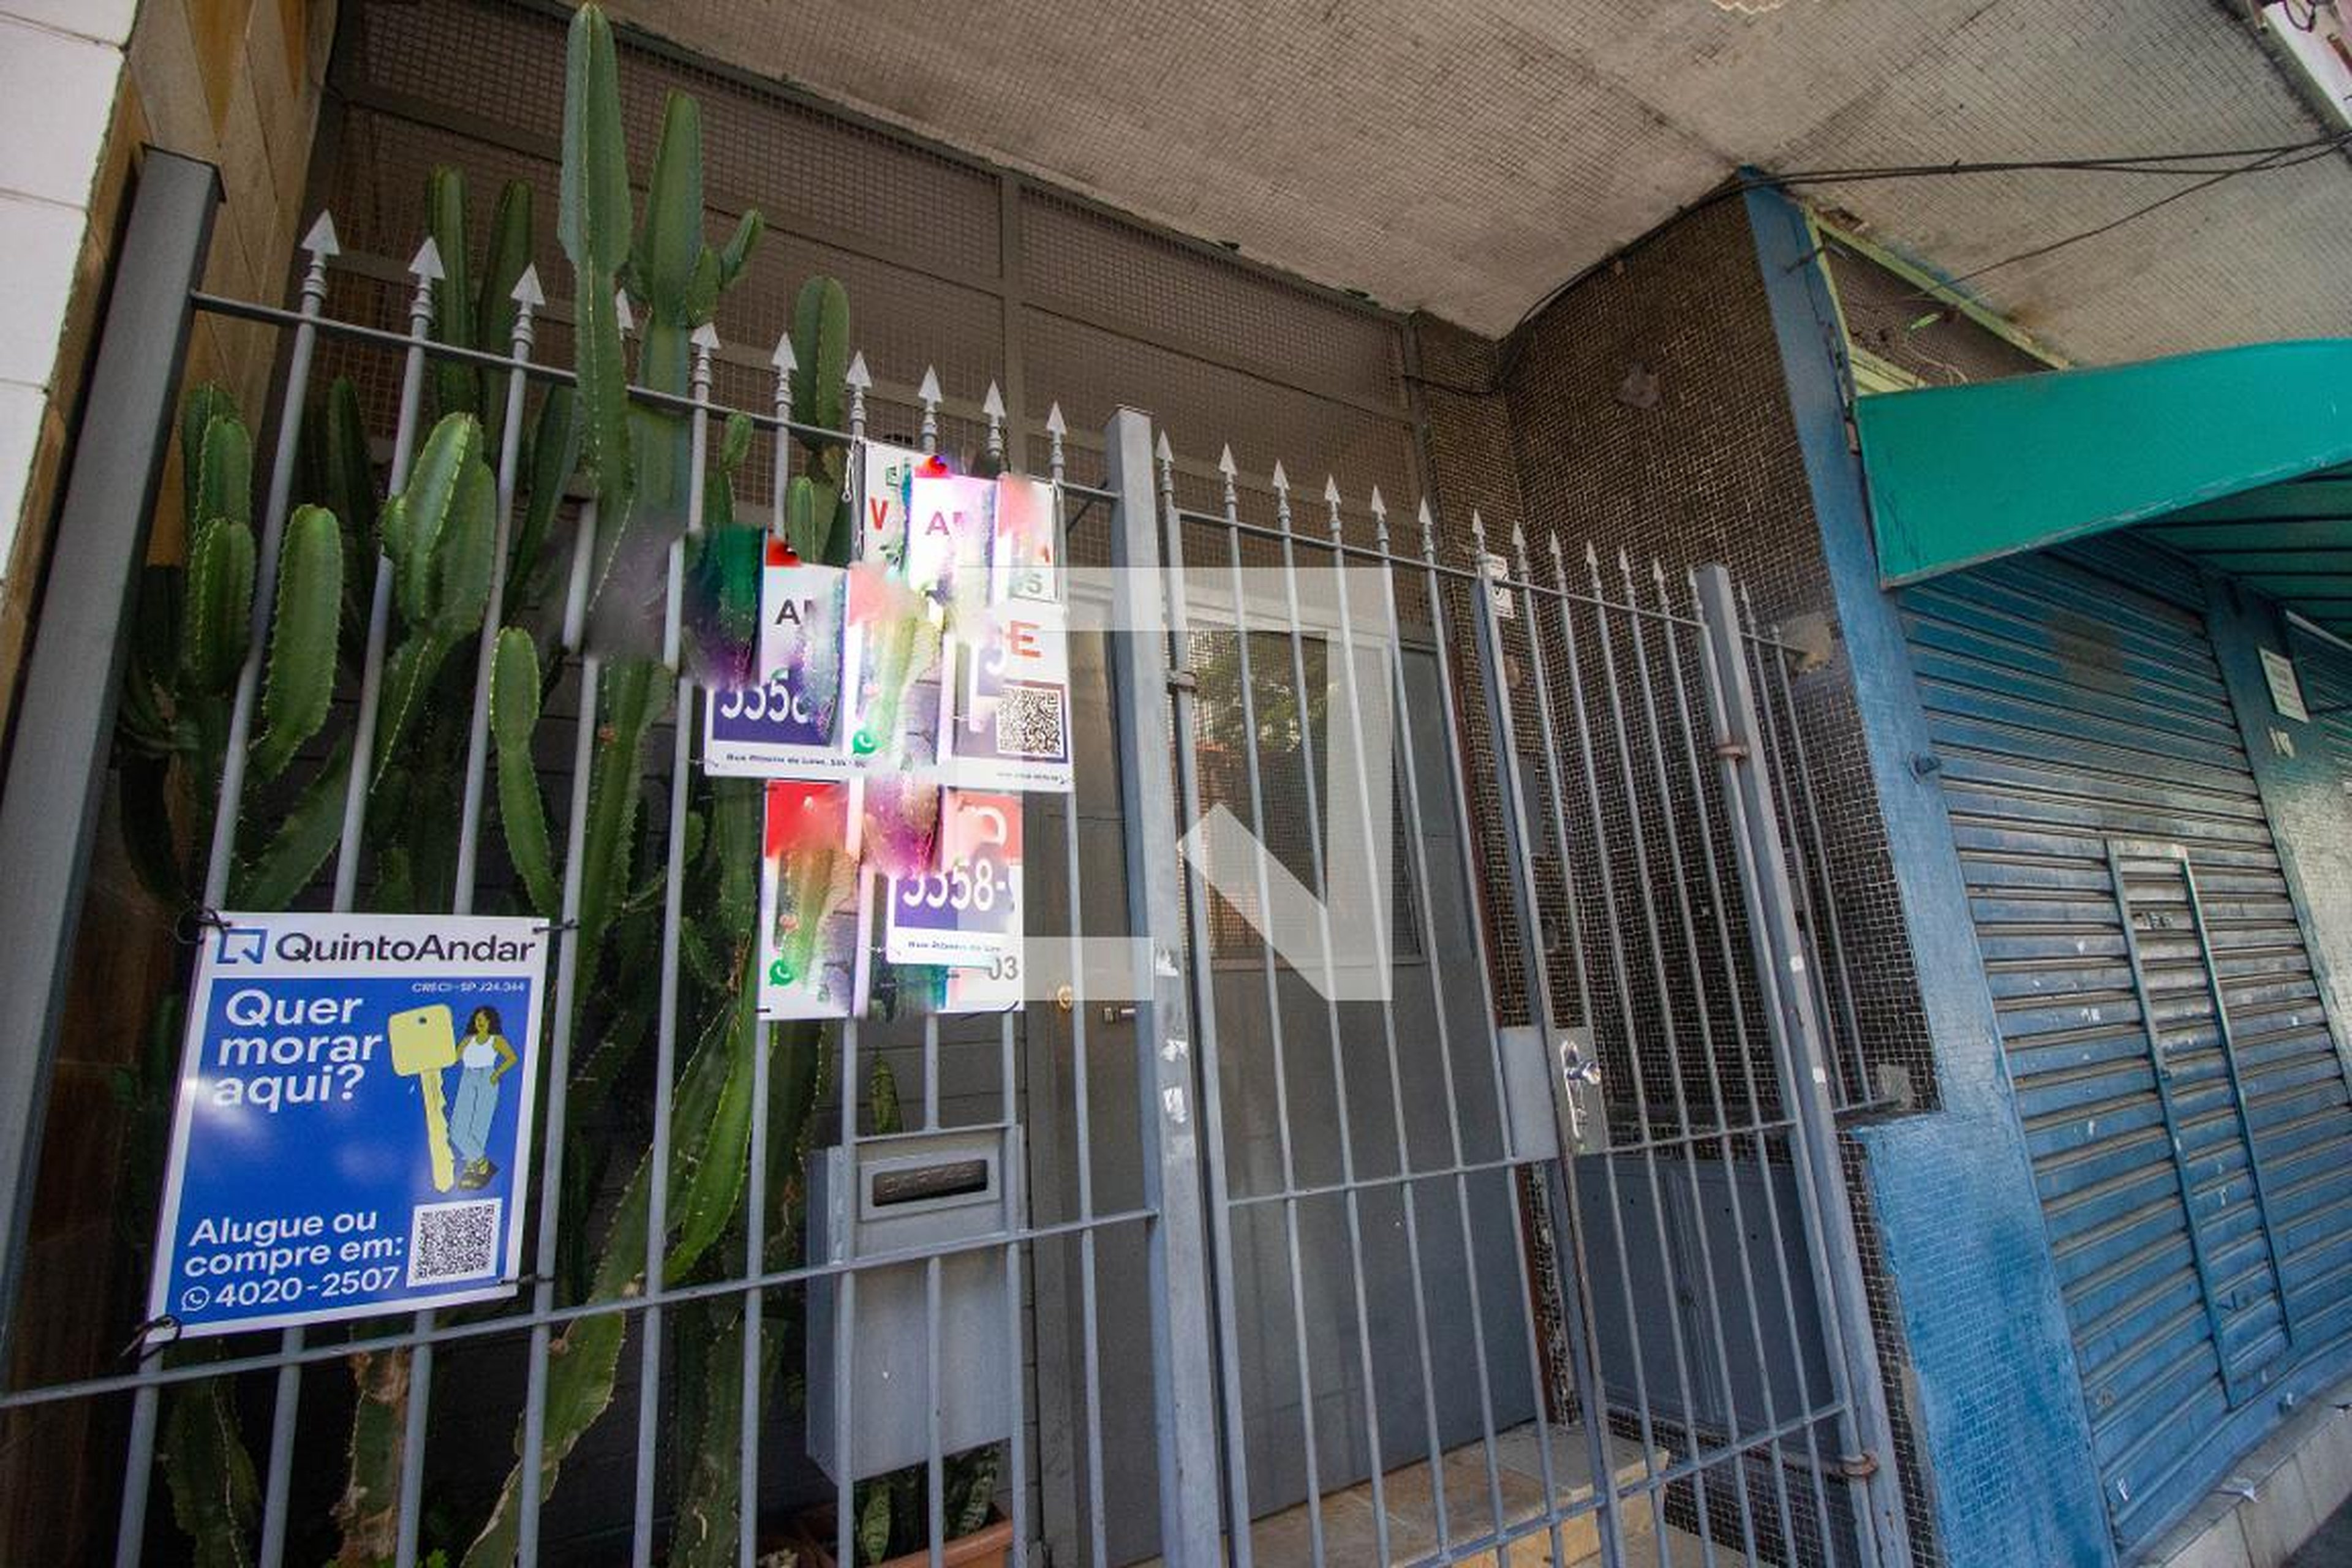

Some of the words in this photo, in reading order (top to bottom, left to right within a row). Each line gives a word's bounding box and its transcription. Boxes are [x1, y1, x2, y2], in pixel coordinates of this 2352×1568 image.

[276, 933, 536, 962] QuintoAndar
[225, 989, 363, 1027] Quer
[217, 1035, 383, 1067] morar
[213, 1063, 365, 1112] aqui?
[189, 1218, 323, 1248] Alugue
[334, 1212, 377, 1234] ou
[184, 1242, 331, 1275] compre
[340, 1236, 405, 1262] em:
[215, 1265, 400, 1307] 4020-2507
